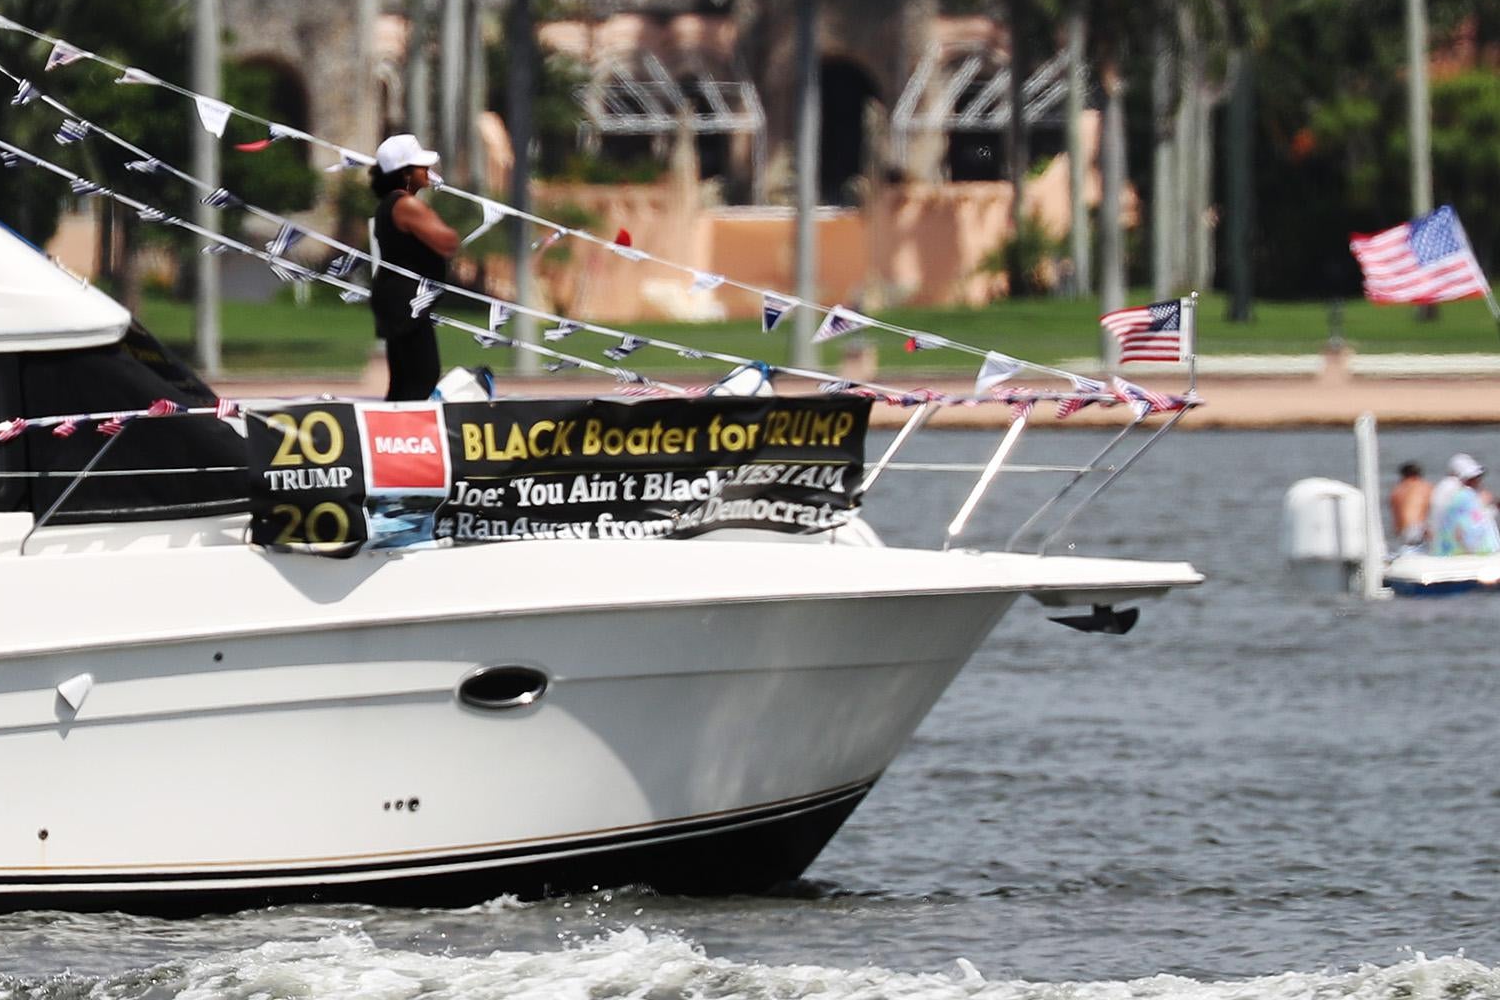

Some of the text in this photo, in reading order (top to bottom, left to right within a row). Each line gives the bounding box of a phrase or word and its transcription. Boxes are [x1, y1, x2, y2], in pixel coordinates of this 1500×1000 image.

[267, 410, 344, 466] 20
[374, 436, 437, 454] MAGA
[461, 419, 576, 461] BLACK
[582, 419, 698, 456] Boater
[708, 413, 760, 451] for
[263, 466, 352, 491] TRUMP
[450, 481, 505, 508] Joe:
[568, 472, 638, 503] Ain't
[271, 502, 350, 548] 20
[595, 512, 675, 540] from
